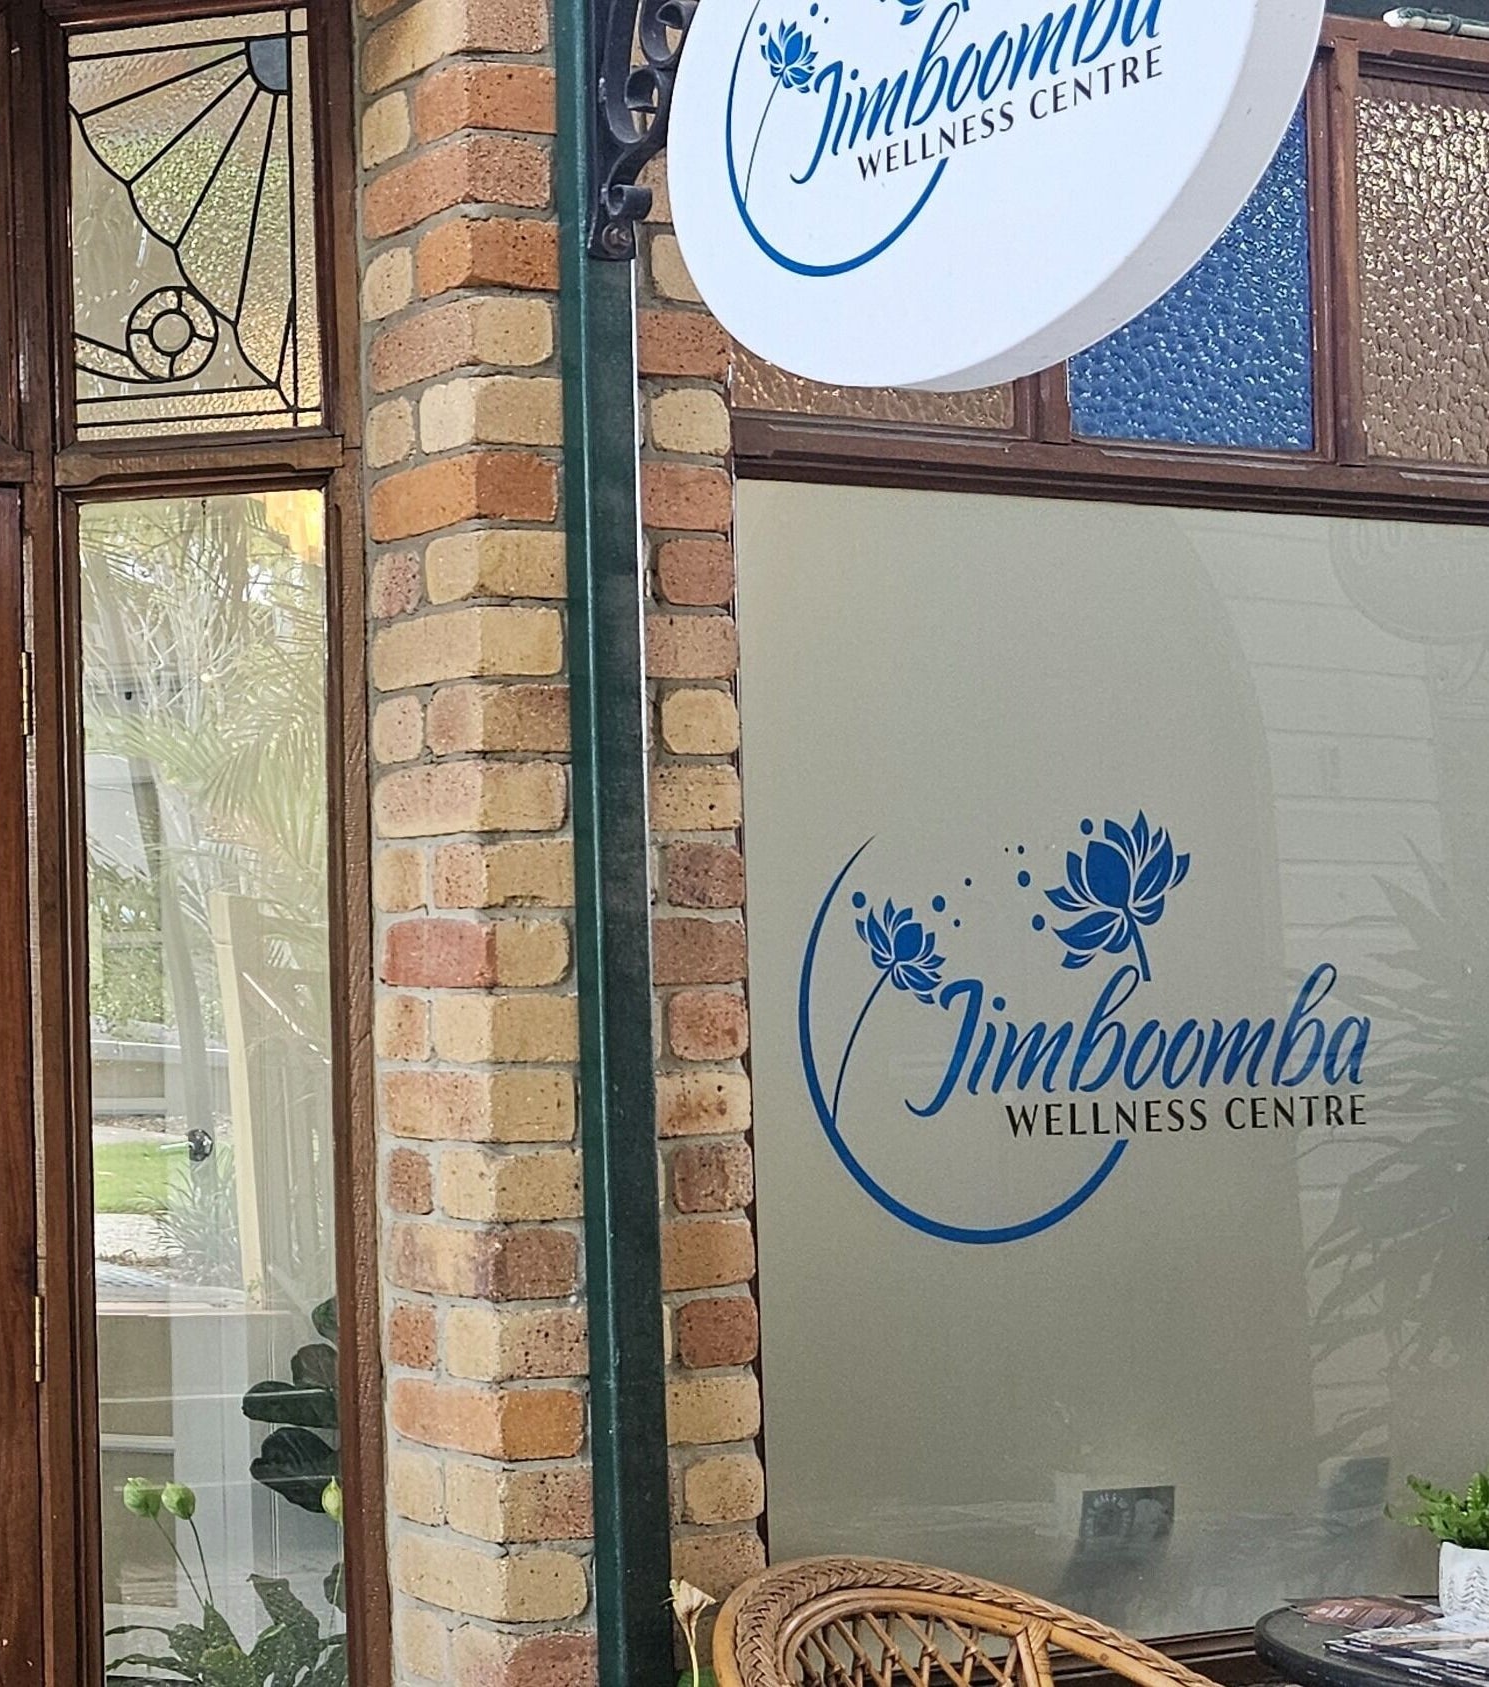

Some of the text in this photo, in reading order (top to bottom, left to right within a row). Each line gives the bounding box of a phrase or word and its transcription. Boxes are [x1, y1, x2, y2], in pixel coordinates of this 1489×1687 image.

[791, 0, 1162, 184] Jimboomba
[858, 45, 1163, 181] WELLNESS CENTRE
[906, 963, 1371, 1117] Jimboomba
[1005, 1094, 1368, 1138] WELLNESS CENTRE
